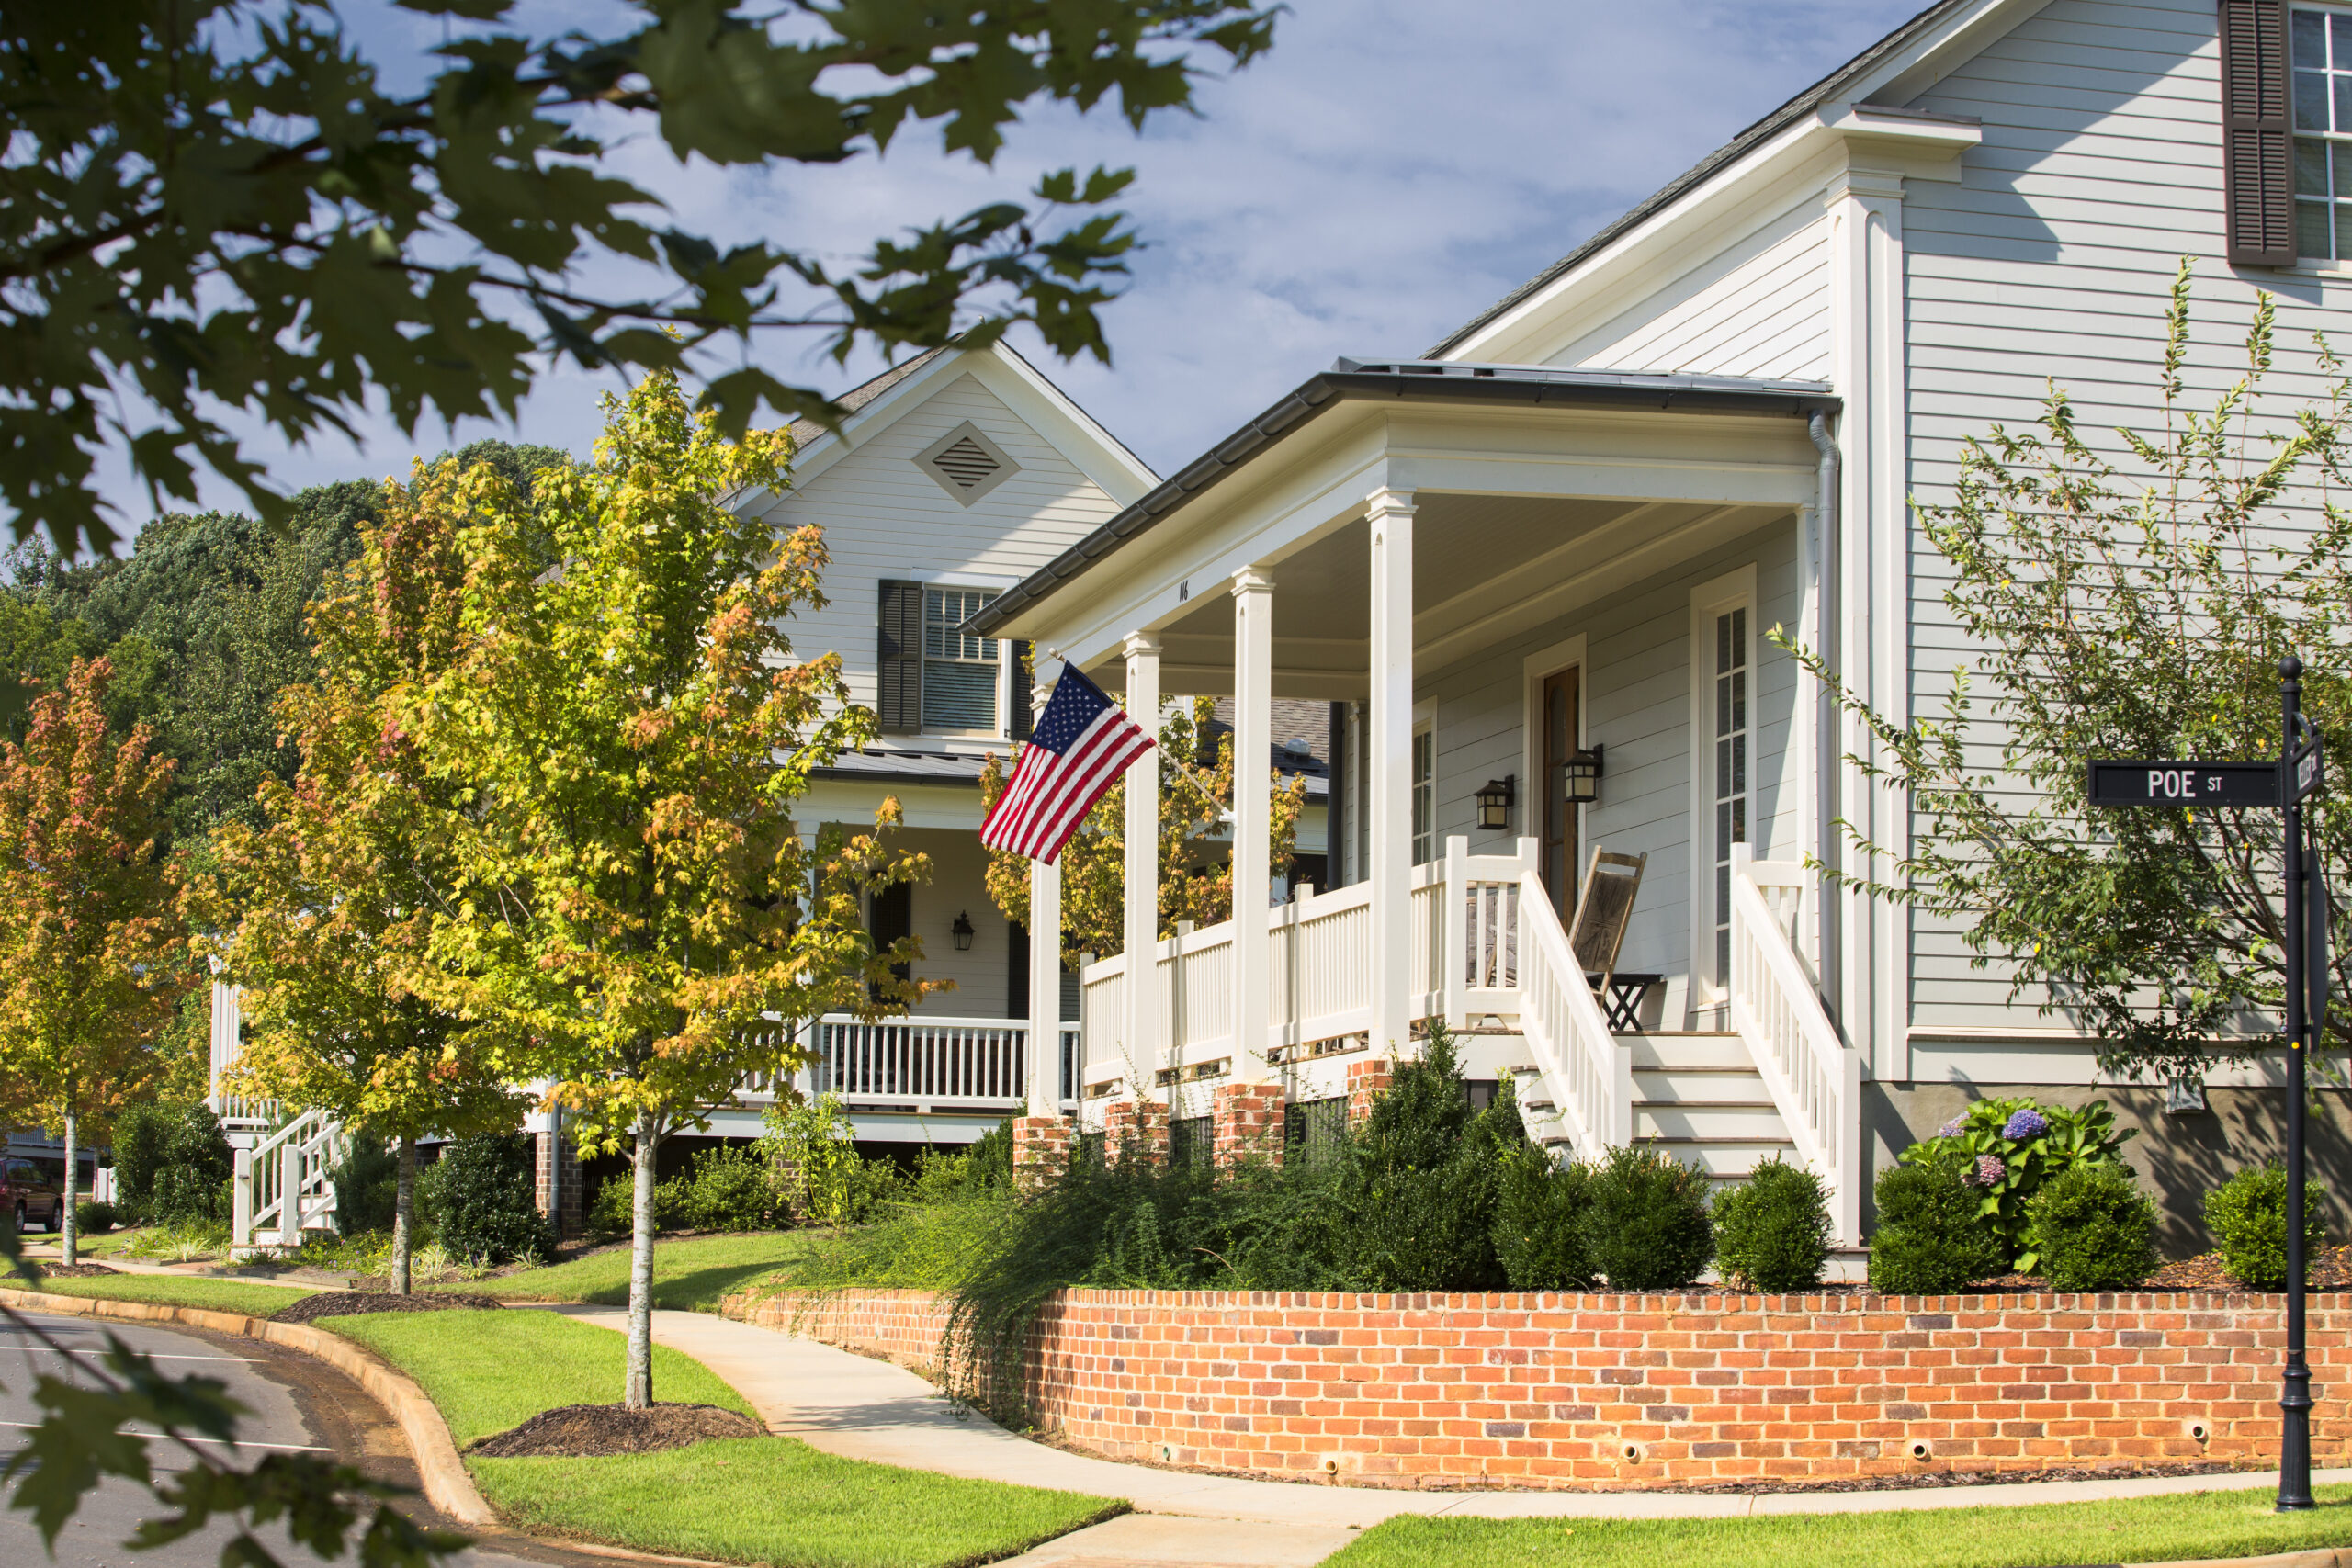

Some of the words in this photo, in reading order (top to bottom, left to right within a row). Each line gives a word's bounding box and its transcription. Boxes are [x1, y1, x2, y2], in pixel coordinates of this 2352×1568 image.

[1180, 580, 1188, 603] 116
[2148, 770, 2196, 797] POE
[2207, 776, 2222, 792] ST
